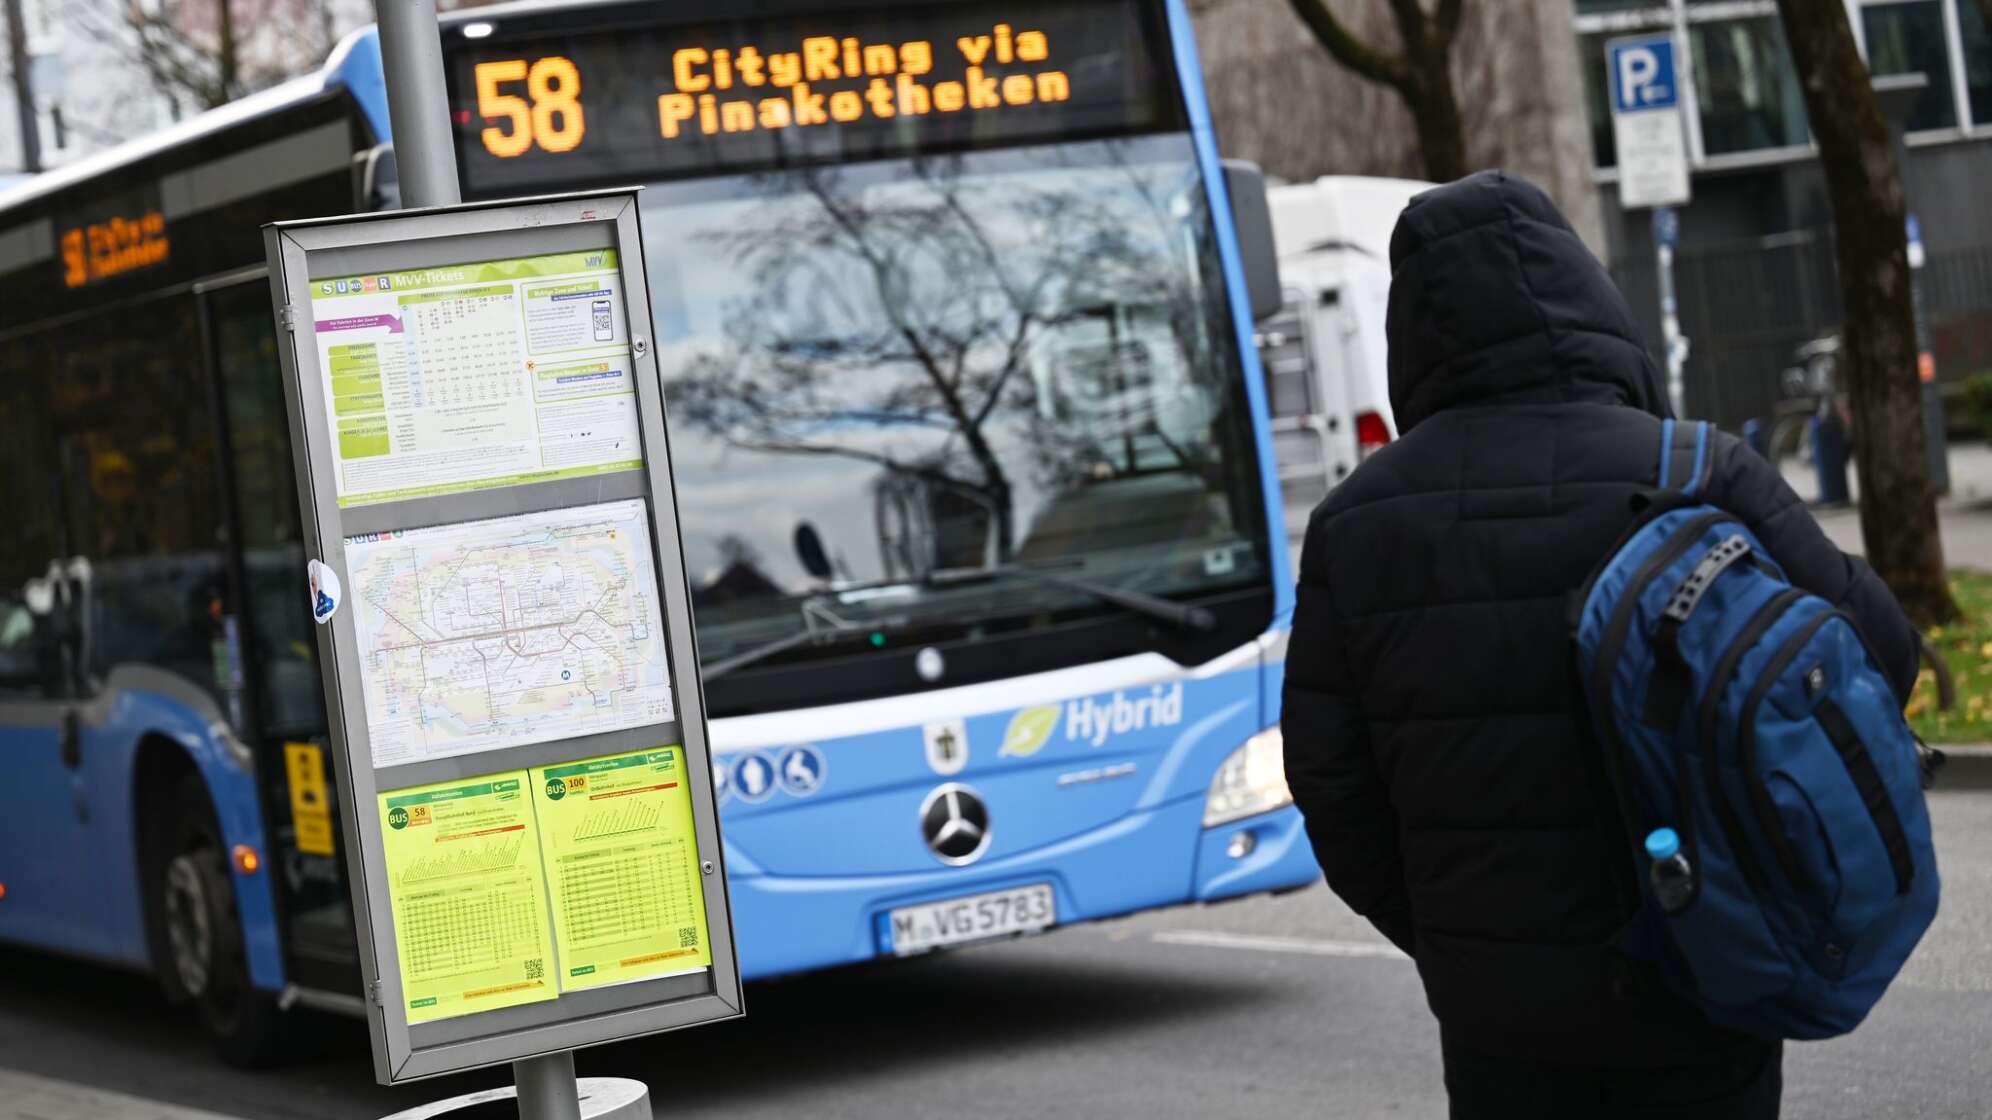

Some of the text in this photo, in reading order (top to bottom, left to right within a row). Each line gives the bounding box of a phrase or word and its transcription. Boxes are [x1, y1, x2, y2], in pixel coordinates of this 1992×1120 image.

[672, 23, 1049, 93] CityRing via
[1618, 47, 1660, 107] P
[474, 56, 586, 159] 58
[658, 66, 1071, 139] Pinakotheken
[395, 270, 465, 287] MVV-Tickets
[1066, 681, 1182, 747] Hybrid
[389, 812, 408, 824] BUS
[414, 807, 426, 817] 58
[547, 778, 585, 795] BUS 100
[894, 914, 918, 944] M
